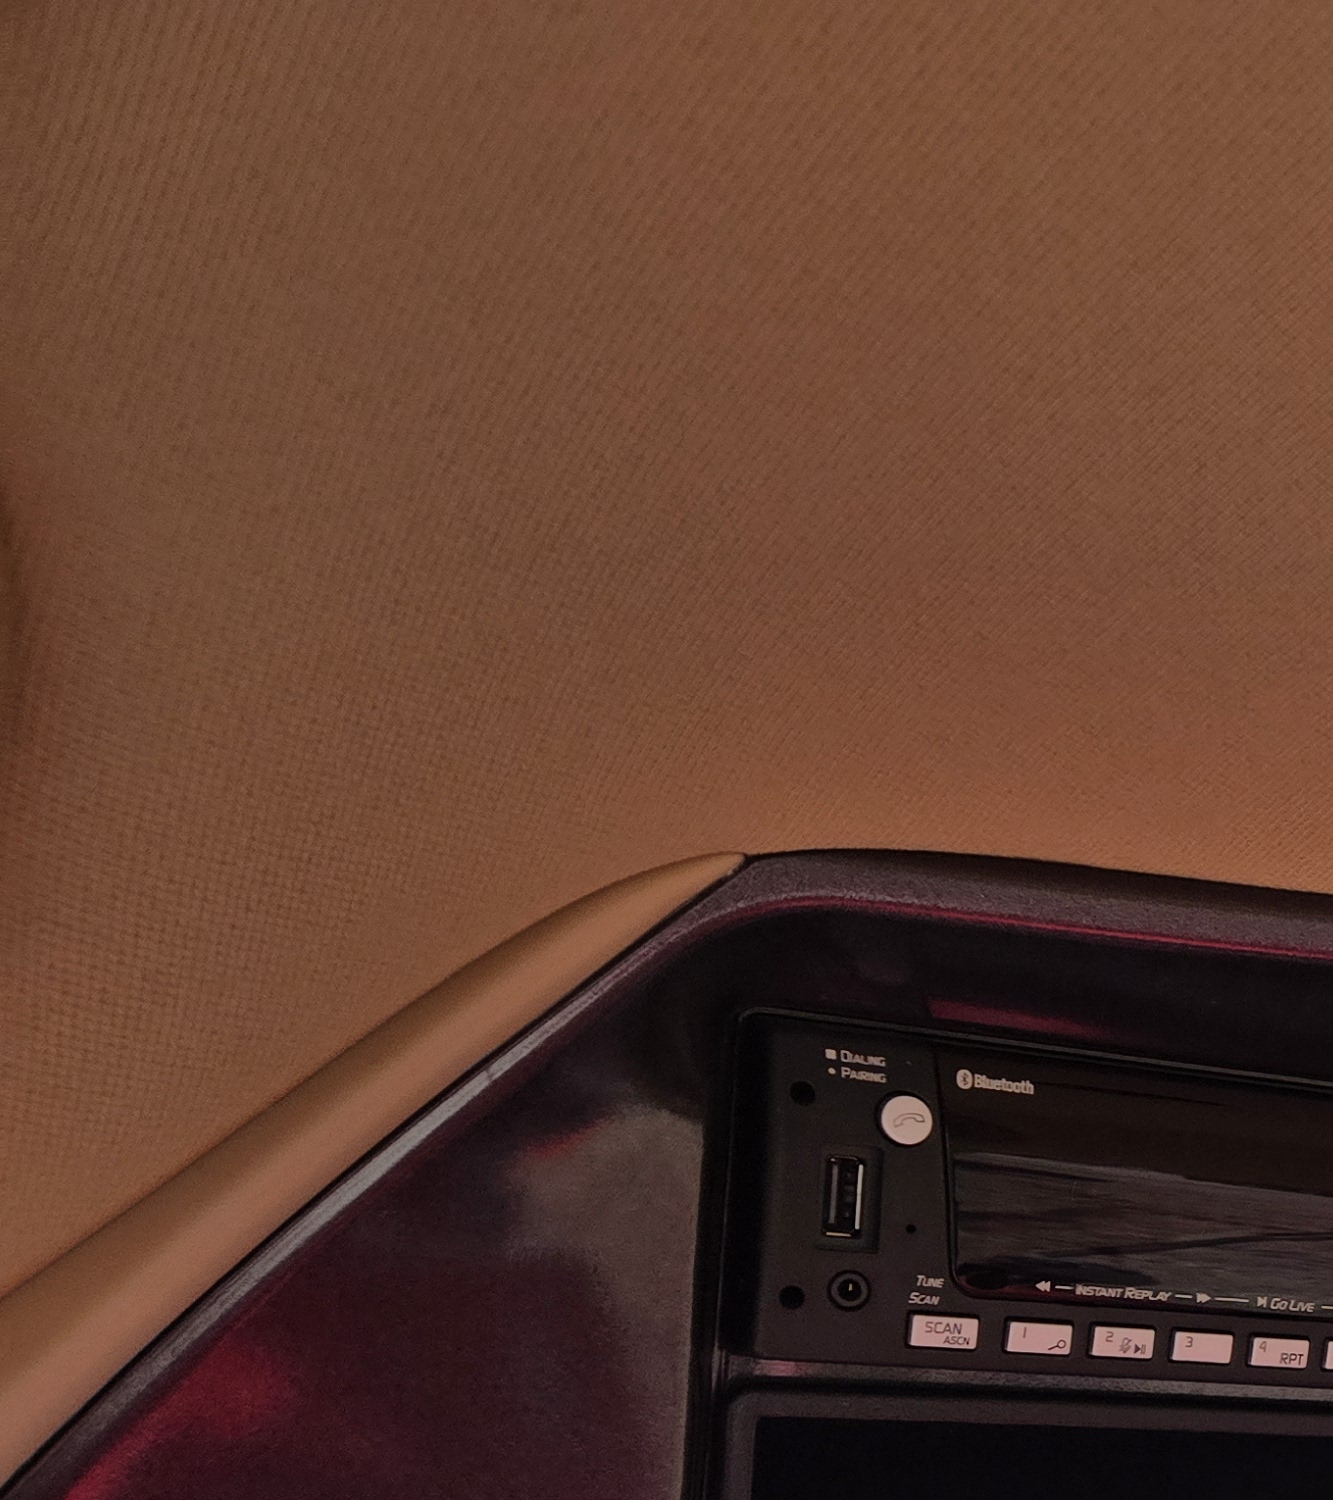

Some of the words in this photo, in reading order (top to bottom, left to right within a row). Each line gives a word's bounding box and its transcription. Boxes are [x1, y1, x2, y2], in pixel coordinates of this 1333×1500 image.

[974, 1073, 1034, 1094] Bluetooth
[916, 1275, 944, 1289] TUNE
[909, 1292, 939, 1306] SCAN
[925, 1320, 962, 1336] SCAN
[943, 1334, 970, 1347] ASCN
[1105, 1331, 1114, 1343] 2
[1185, 1336, 1194, 1348] 3
[1259, 1341, 1268, 1353] 4
[1280, 1351, 1304, 1366] RPT
